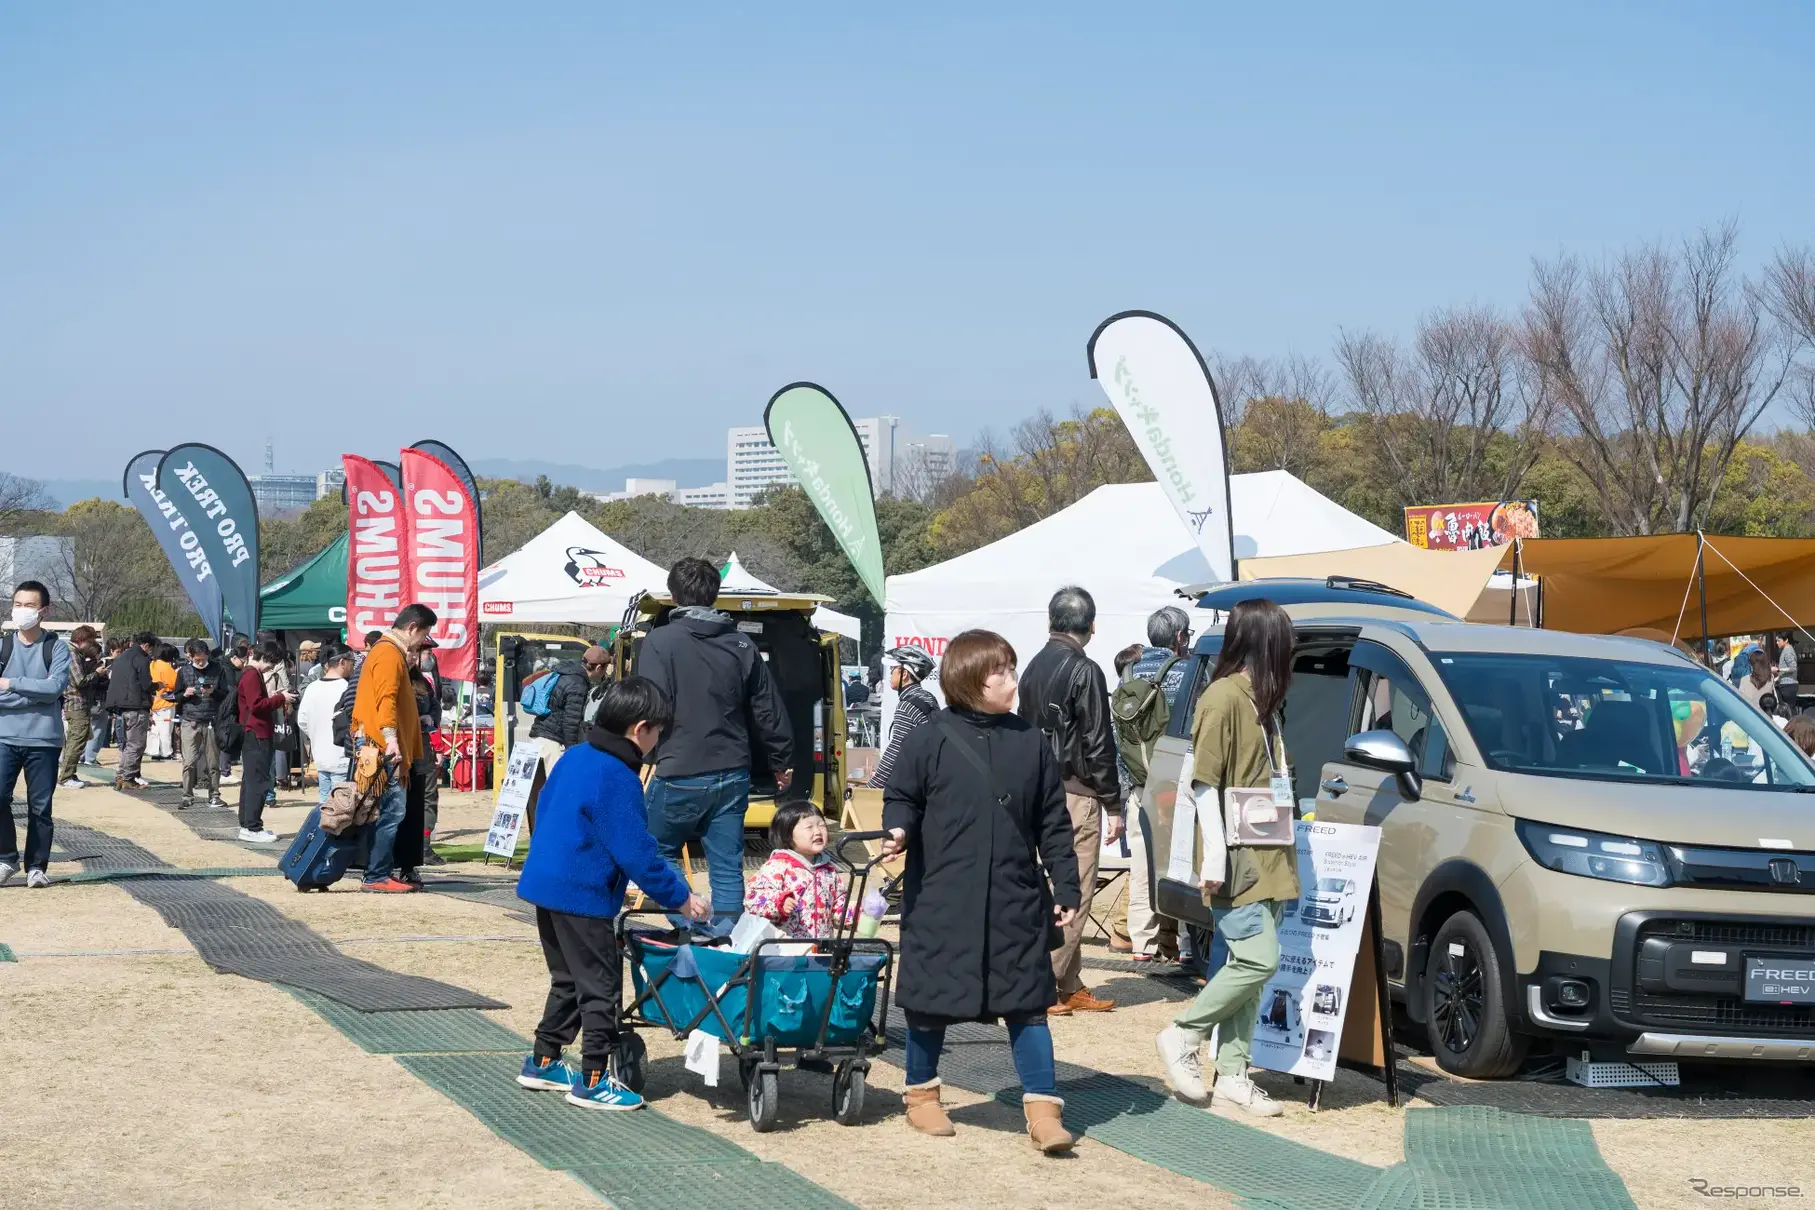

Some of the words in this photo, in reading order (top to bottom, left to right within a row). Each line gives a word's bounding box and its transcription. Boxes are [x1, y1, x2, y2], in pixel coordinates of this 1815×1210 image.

[586, 568, 624, 578] CHUMS
[484, 603, 512, 612] CHUMS
[1296, 825, 1337, 835] FREED
